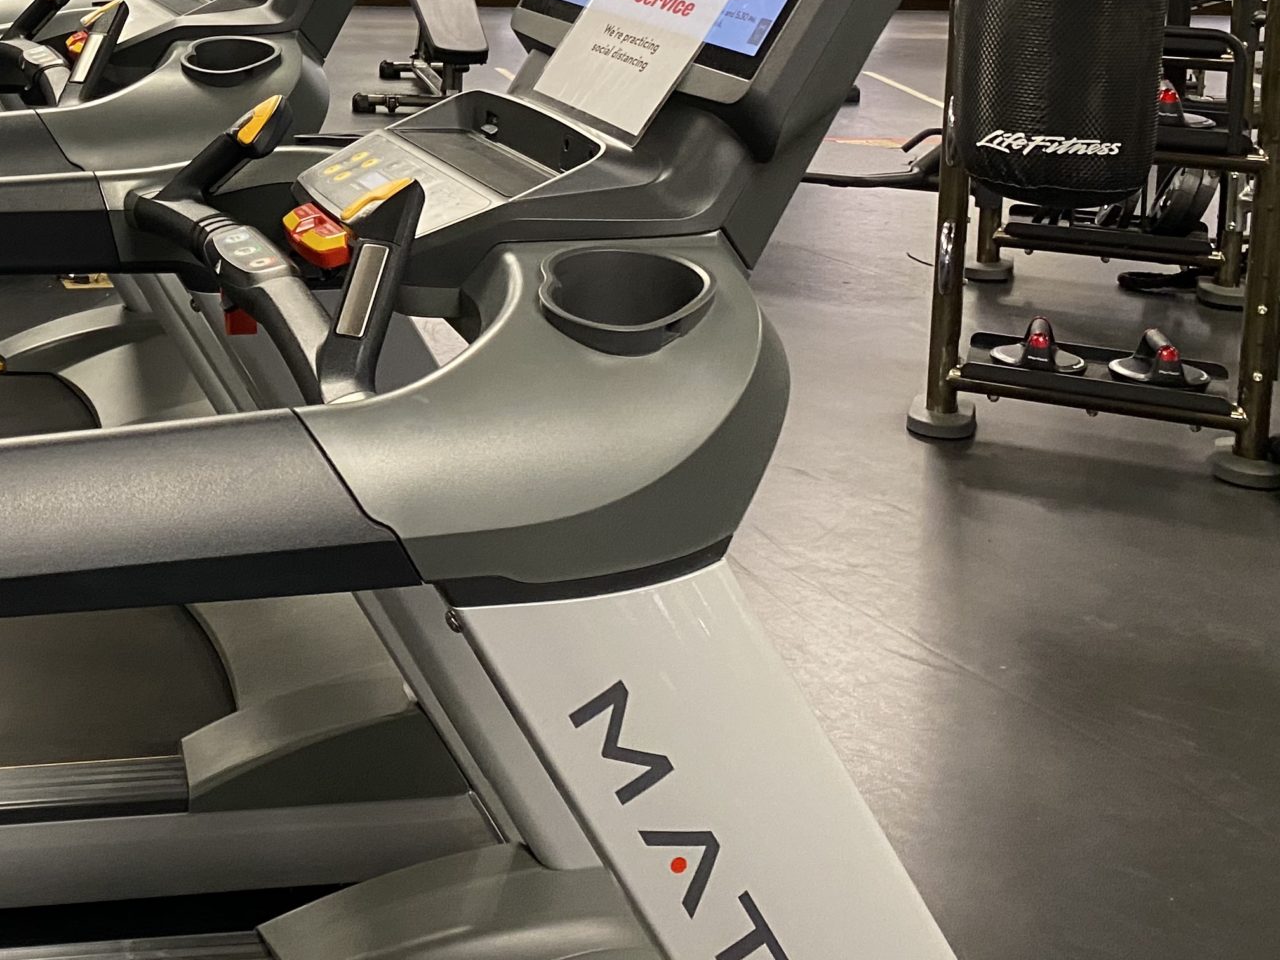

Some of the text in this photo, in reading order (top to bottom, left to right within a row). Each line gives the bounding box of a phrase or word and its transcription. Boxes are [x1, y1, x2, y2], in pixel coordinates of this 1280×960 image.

[604, 24, 660, 55] We're practicing
[592, 44, 649, 72] social distancing
[976, 129, 1122, 156] Life Fitness
[568, 679, 790, 960] MAT
